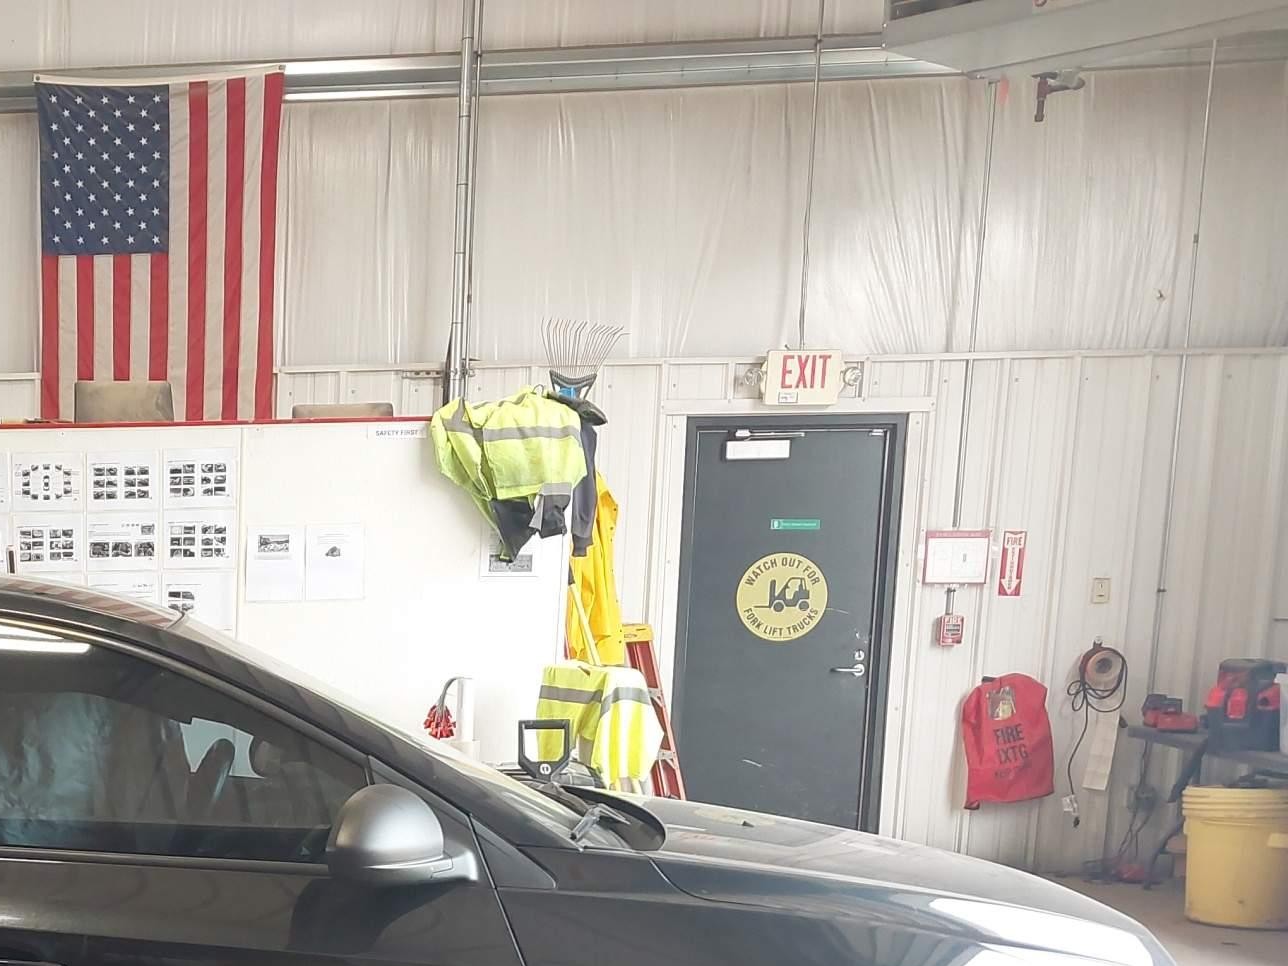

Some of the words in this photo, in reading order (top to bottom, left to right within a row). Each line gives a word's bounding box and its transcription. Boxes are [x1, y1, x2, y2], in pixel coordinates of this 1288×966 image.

[780, 354, 832, 389] EXIT
[1006, 536, 1023, 546] FIRE
[744, 558, 778, 587] WATCH
[781, 557, 803, 569] OUT
[802, 565, 821, 586] FOR
[743, 607, 763, 631] FORK
[763, 624, 784, 637] LIFT
[786, 607, 819, 635] TRUCKS
[993, 723, 1024, 745] FIRE
